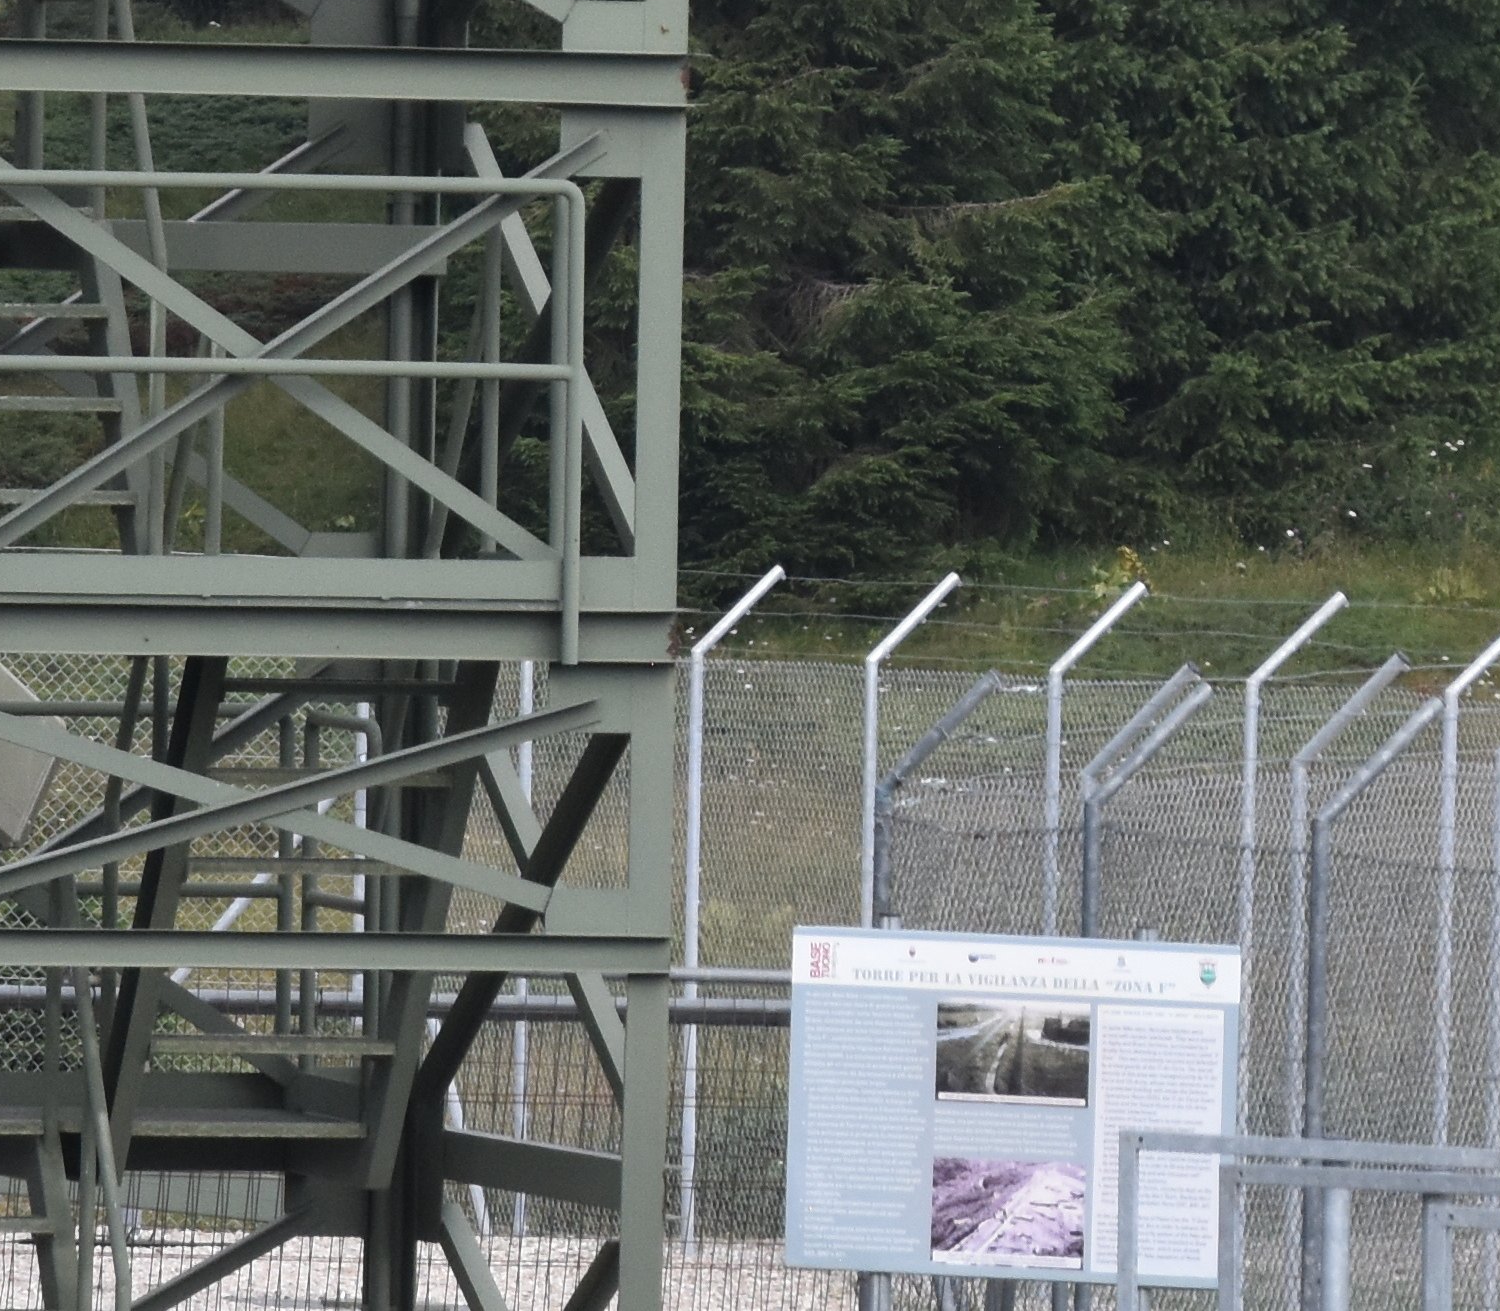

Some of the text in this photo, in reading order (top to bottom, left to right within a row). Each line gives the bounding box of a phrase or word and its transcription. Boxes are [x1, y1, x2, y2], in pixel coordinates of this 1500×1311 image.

[810, 942, 821, 977] BASE
[853, 968, 902, 982] TORRE
[909, 970, 939, 983] PER
[945, 972, 962, 985] LA
[968, 973, 1047, 988] VIGILANZA
[1053, 977, 1100, 990] DELLA
